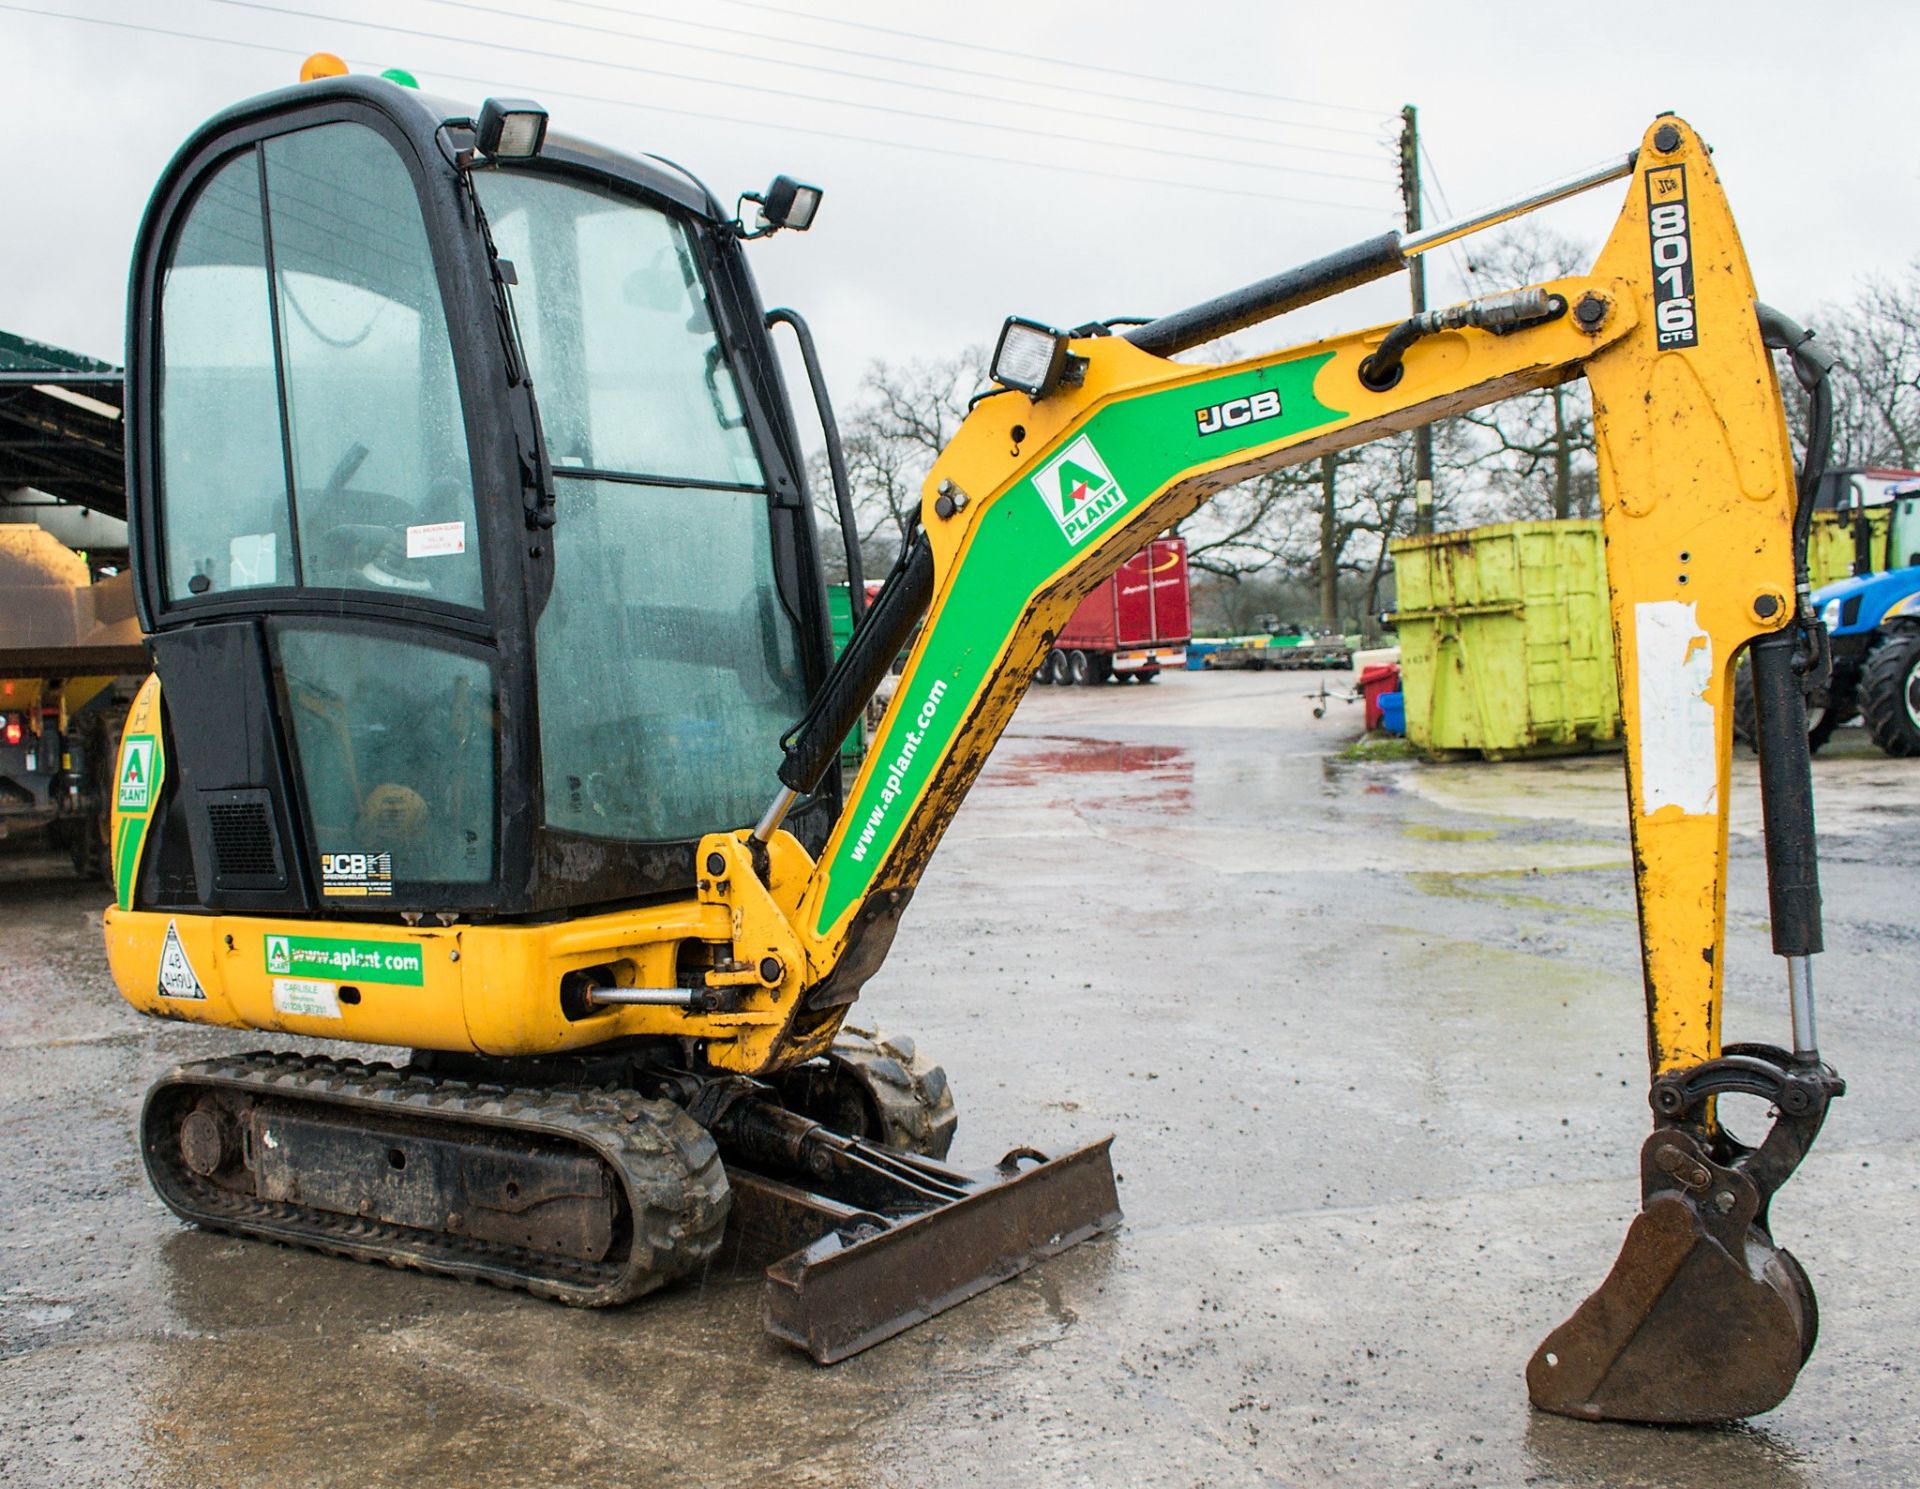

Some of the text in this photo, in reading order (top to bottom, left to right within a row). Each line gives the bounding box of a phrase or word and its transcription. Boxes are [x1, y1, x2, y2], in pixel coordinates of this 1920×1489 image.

[1658, 178, 1679, 194] JCB
[1651, 204, 1694, 332] 8016
[1659, 330, 1694, 344] CTS
[1198, 391, 1281, 435] JCB
[1057, 459, 1106, 518] A
[1065, 486, 1121, 539] PLANT
[123, 748, 145, 783] A
[850, 679, 948, 863] www.aplant.com
[120, 788, 146, 802] PLANT
[322, 854, 367, 874] JCB
